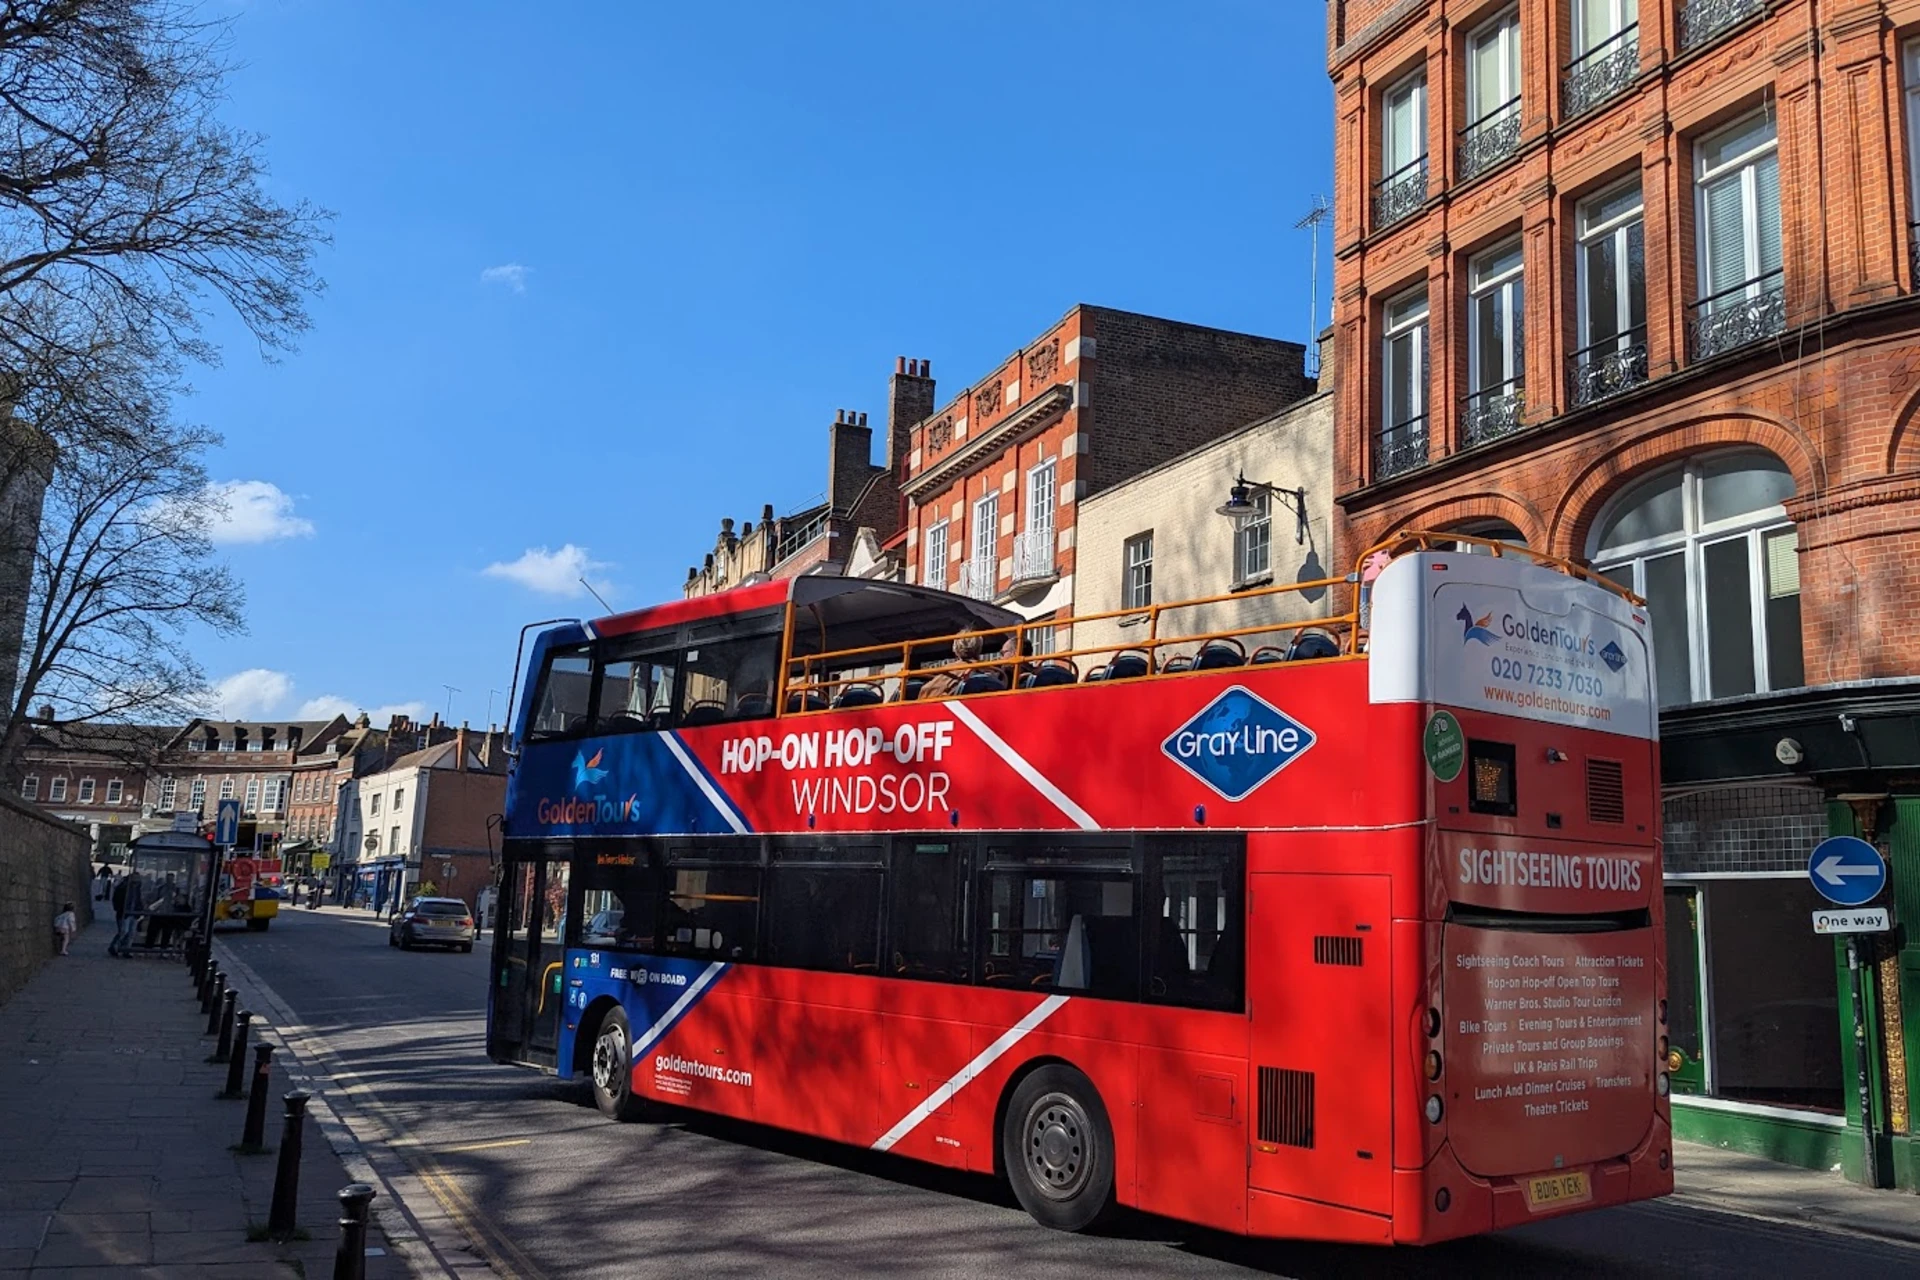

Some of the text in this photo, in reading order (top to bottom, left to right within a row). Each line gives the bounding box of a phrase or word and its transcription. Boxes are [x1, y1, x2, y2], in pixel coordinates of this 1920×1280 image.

[1505, 642, 1539, 658] Experience
[1491, 656, 1603, 697] 020 7233 7030
[1484, 685, 1611, 721] www.goldentours.com
[721, 720, 954, 775] HOP-ON HOP-OFF
[791, 771, 951, 815] WINDSOR
[1459, 848, 1642, 892] SIGHTSEEING TOURS
[1818, 914, 1883, 928] One way
[1456, 954, 1644, 970] Sightseeing Coach Tours Attraction Tickets
[609, 967, 628, 980] FREE
[649, 972, 661, 983] ON
[661, 973, 687, 986] BOARD
[1487, 975, 1620, 990] Hop-on Hop-off Open Top Tours
[1484, 995, 1622, 1011] Warner Bros. Studio Tour London
[1459, 1014, 1642, 1034] Bike Tours Evening Tours & Entertainment
[1483, 1035, 1624, 1055] Private Tours and Group Bookings
[655, 1054, 753, 1087] goldentours.com
[1513, 1057, 1598, 1075] UK & Paris Rail Trips
[1475, 1074, 1632, 1100] Lunch And Dinner Cruises Transfers
[1524, 1099, 1589, 1117] Theatre Tickets
[1535, 1176, 1582, 1200] BD16 YEK
